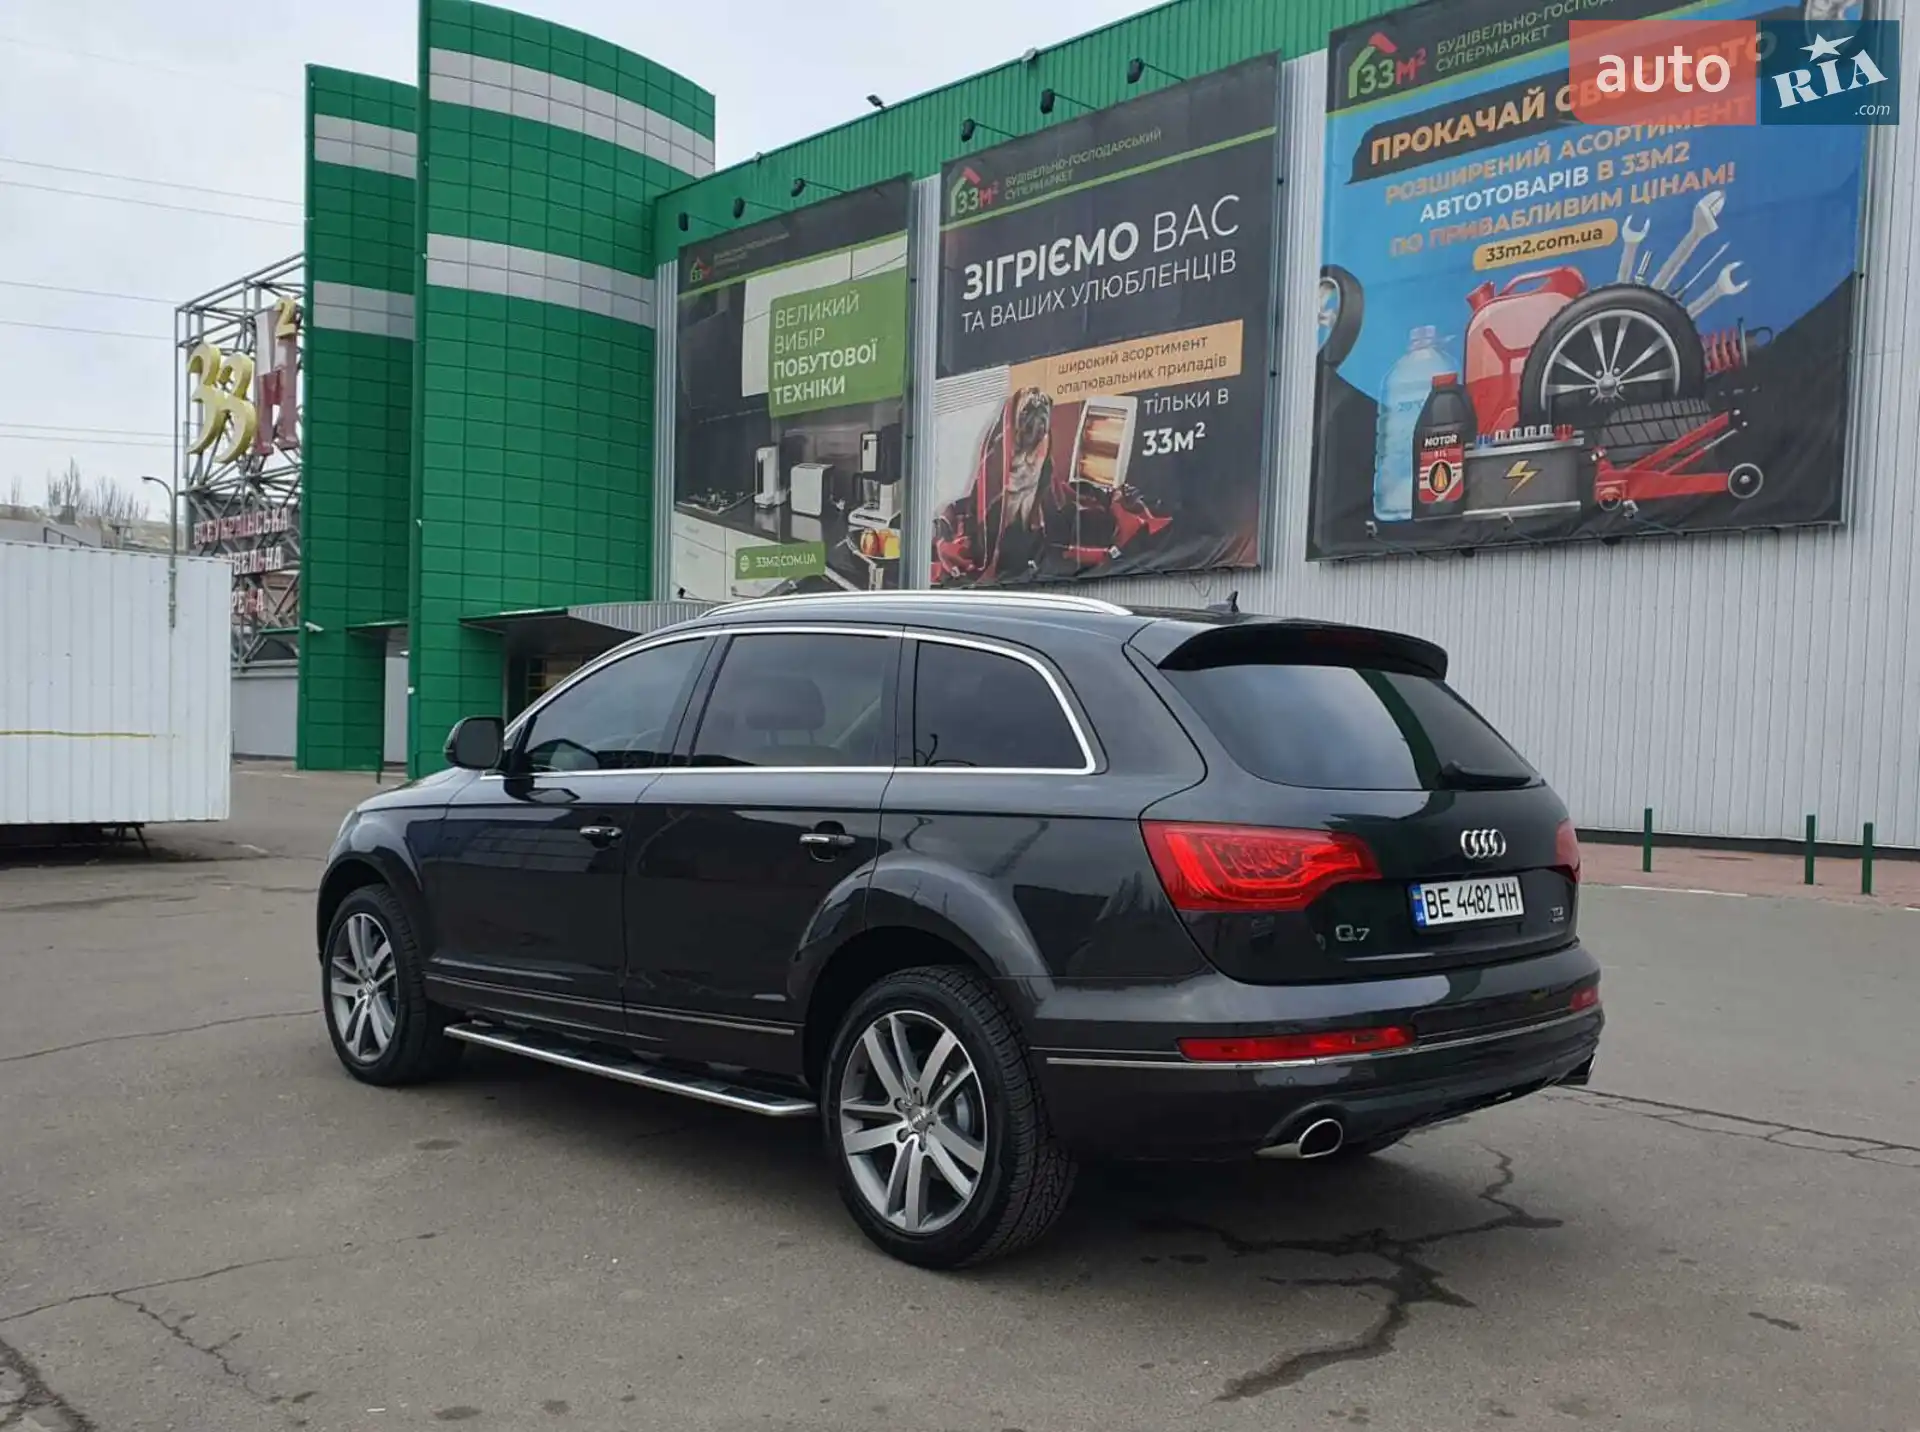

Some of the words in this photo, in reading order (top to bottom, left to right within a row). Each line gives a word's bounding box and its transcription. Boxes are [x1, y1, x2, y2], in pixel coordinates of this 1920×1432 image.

[1436, 24, 1551, 73] СУПЕРМАРКЕТ
[1371, 86, 1546, 165] ПРОКАЧАЙ
[1385, 140, 1551, 206] РОЗШИРЕНИЙ
[1558, 95, 1750, 160] АСОРТИМЕНТ
[1420, 166, 1588, 223] АВТОТОВАРІВ
[1596, 161, 1615, 181] В
[1620, 142, 1691, 177] 33М2
[1389, 231, 1424, 256] ПО
[1428, 187, 1622, 248] ПРИВАБЛИВИМ
[1630, 161, 1736, 205] ЦІНАМ!
[962, 221, 1140, 301] ЗІГРІЄМО
[1153, 194, 1240, 253] ВАС
[1485, 227, 1604, 263] 33m2.com.ua
[775, 290, 860, 329] ВЕЛИКИЙ
[961, 308, 985, 334] ТА
[991, 287, 1066, 328] ВАШИХ
[1071, 249, 1237, 308] УЛЮБЛЕНЦІВ
[773, 338, 878, 380] ПОБУТОВОЇ
[774, 327, 825, 354] ВИБІР
[1058, 354, 1119, 375] широкий
[1122, 336, 1208, 363] асортимент
[772, 375, 846, 405] ТЕХНІКИ
[1056, 369, 1154, 396] опалювальних
[1157, 354, 1227, 380] приладів
[1424, 434, 1458, 447] MOTOR
[1425, 887, 1453, 919] BE
[1457, 884, 1495, 915] 4482
[1496, 882, 1519, 912] HH
[1335, 924, 1370, 941] Q7
